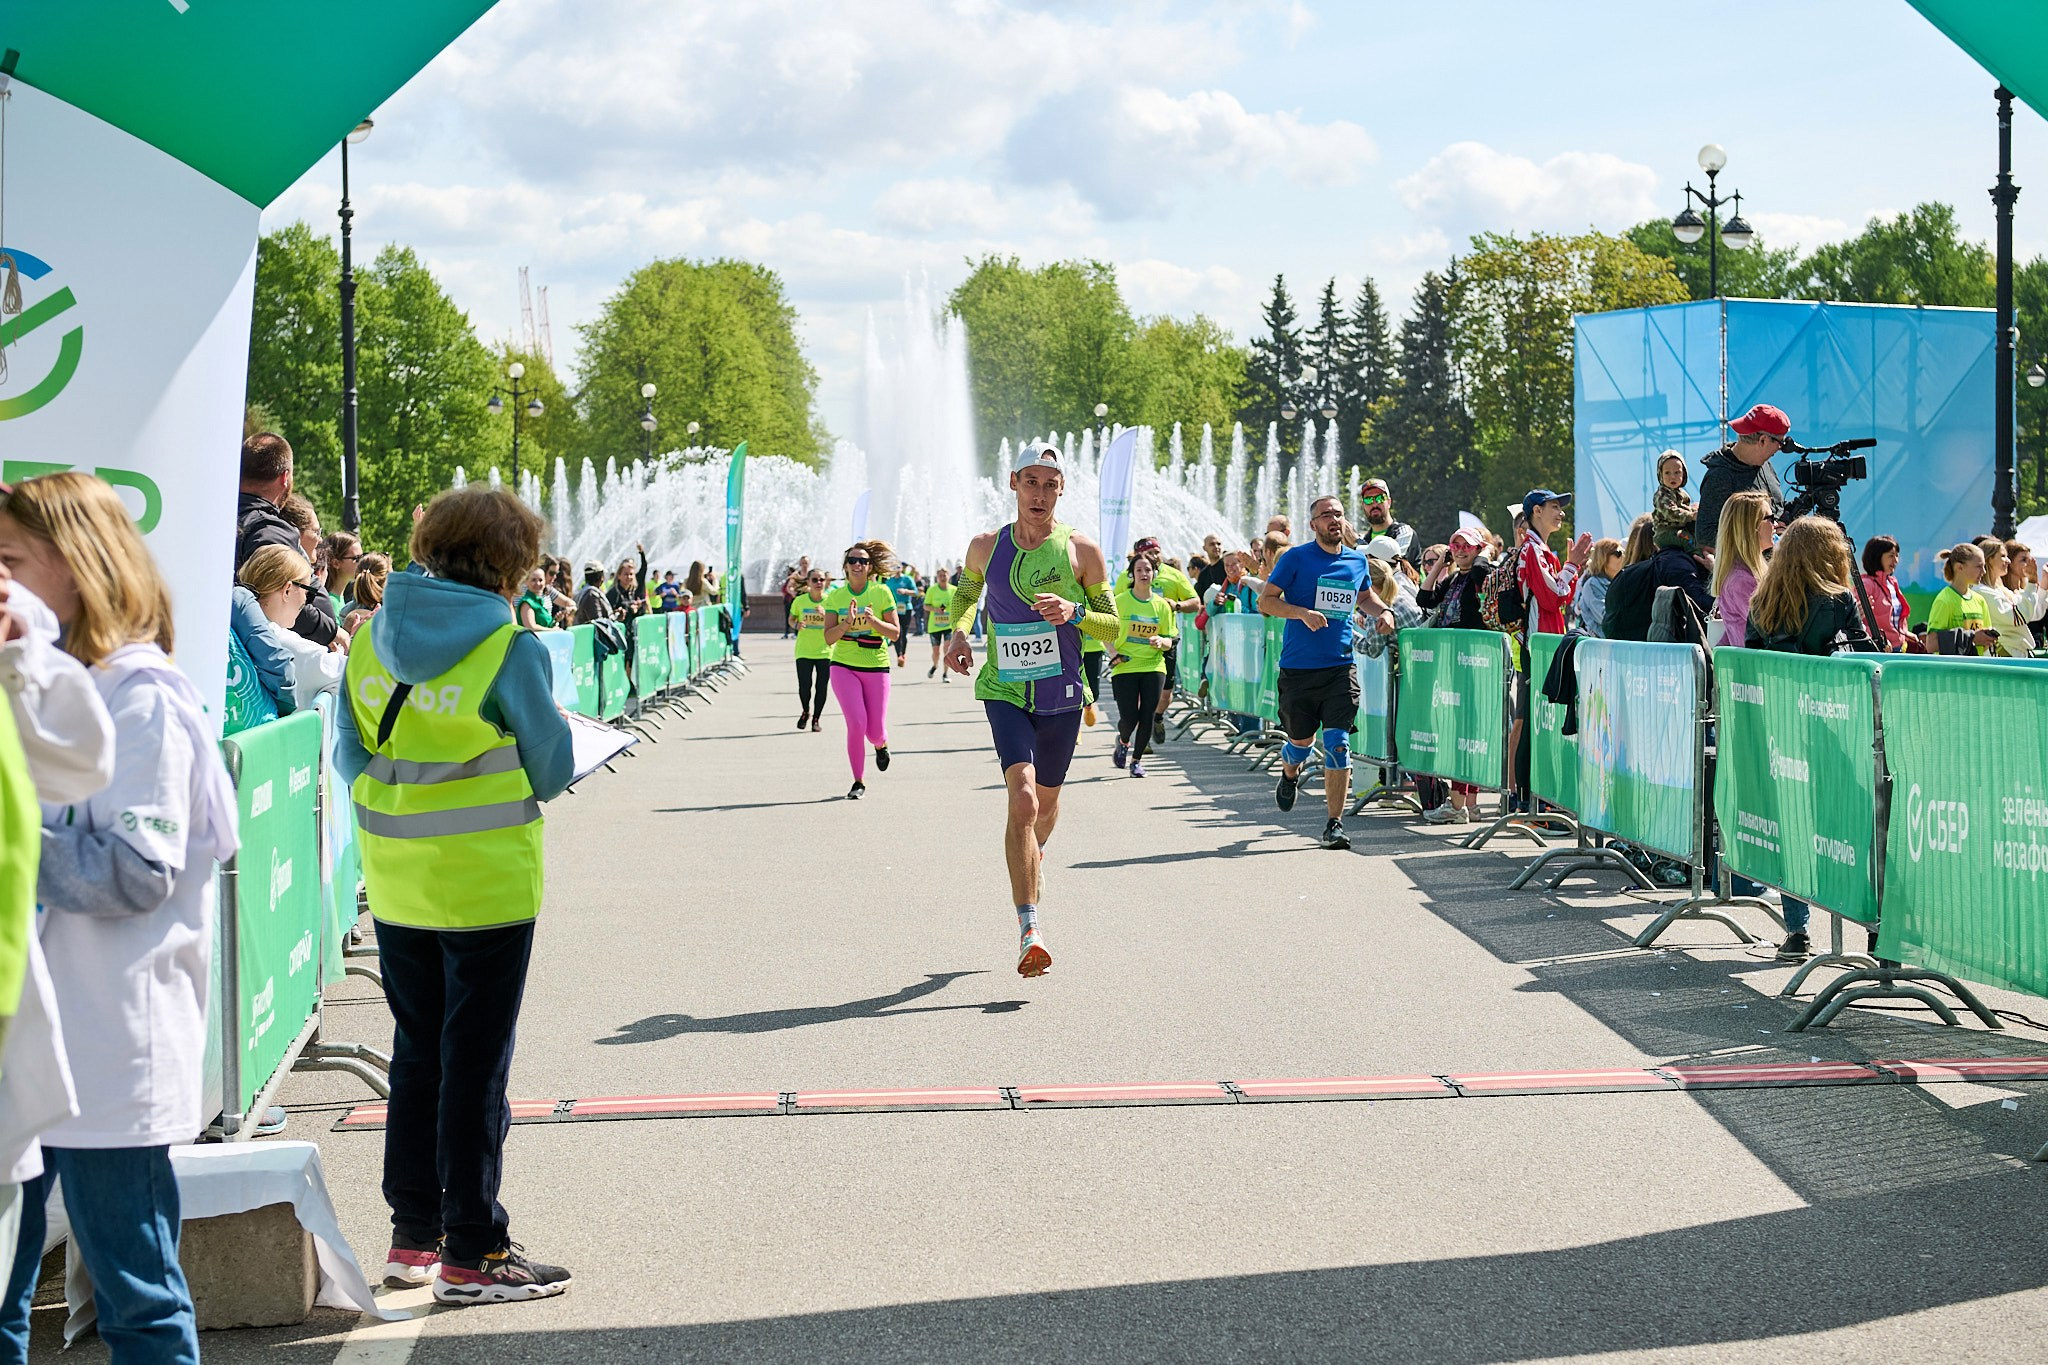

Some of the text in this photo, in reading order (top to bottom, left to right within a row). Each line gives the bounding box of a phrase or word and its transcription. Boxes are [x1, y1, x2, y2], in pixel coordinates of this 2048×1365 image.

[1321, 591, 1352, 604] 10528
[1132, 624, 1157, 633] 11739
[1003, 638, 1054, 658] 10932
[143, 817, 178, 834] СБЕР
[1927, 799, 1969, 854] СБЕР
